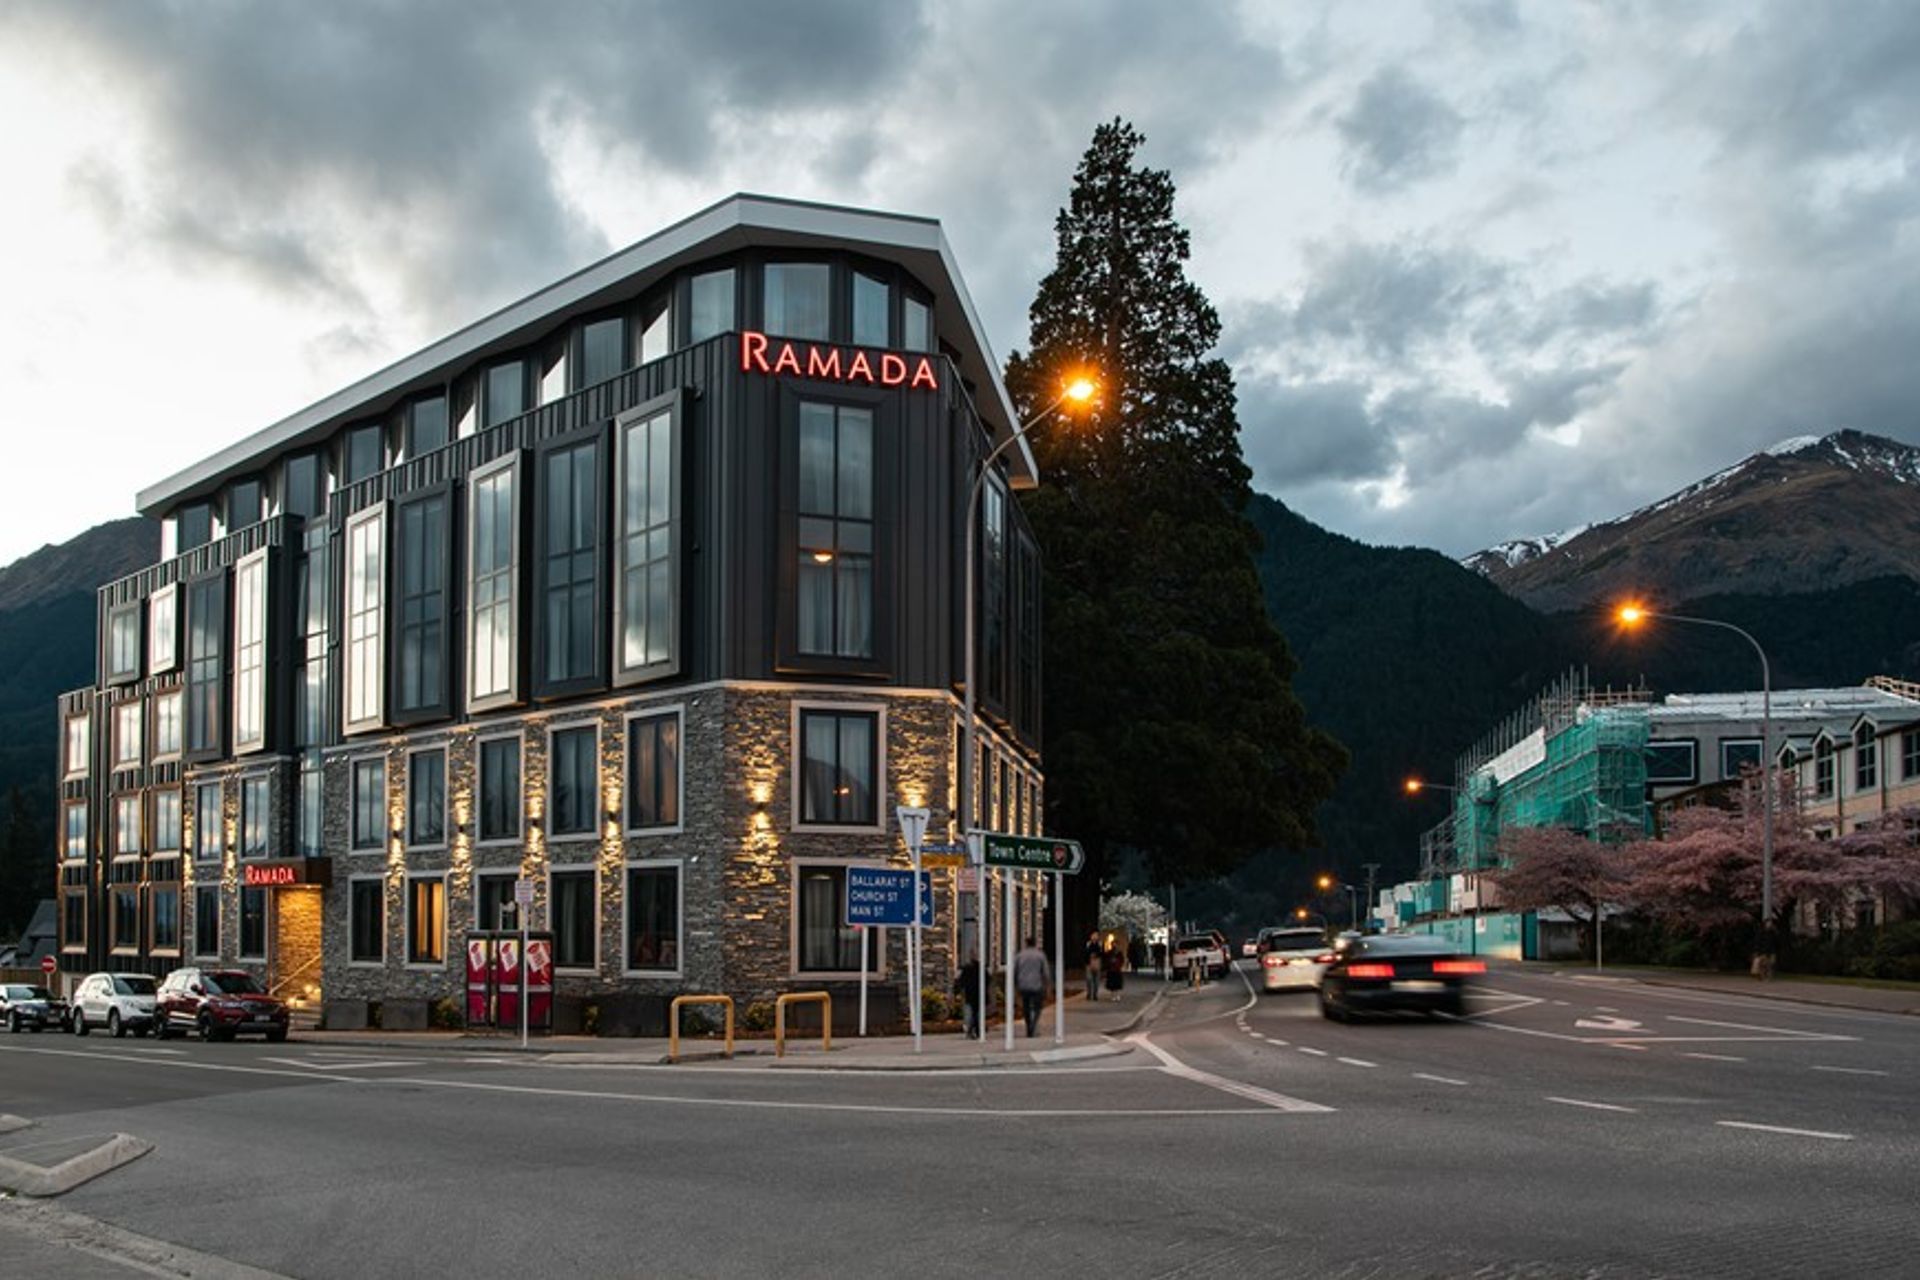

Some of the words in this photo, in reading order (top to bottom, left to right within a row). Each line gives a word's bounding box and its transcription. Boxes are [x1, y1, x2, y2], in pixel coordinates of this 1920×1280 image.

[741, 331, 939, 389] RAMADA
[988, 842, 1015, 859] Town
[1018, 845, 1051, 862] Centre
[245, 864, 296, 884] RAMADA
[850, 874, 897, 887] BALLARAT
[899, 877, 911, 889] ST
[850, 889, 886, 902] CHURCH
[887, 891, 898, 902] ST
[850, 904, 872, 917] MAIN
[873, 905, 885, 917] ST
